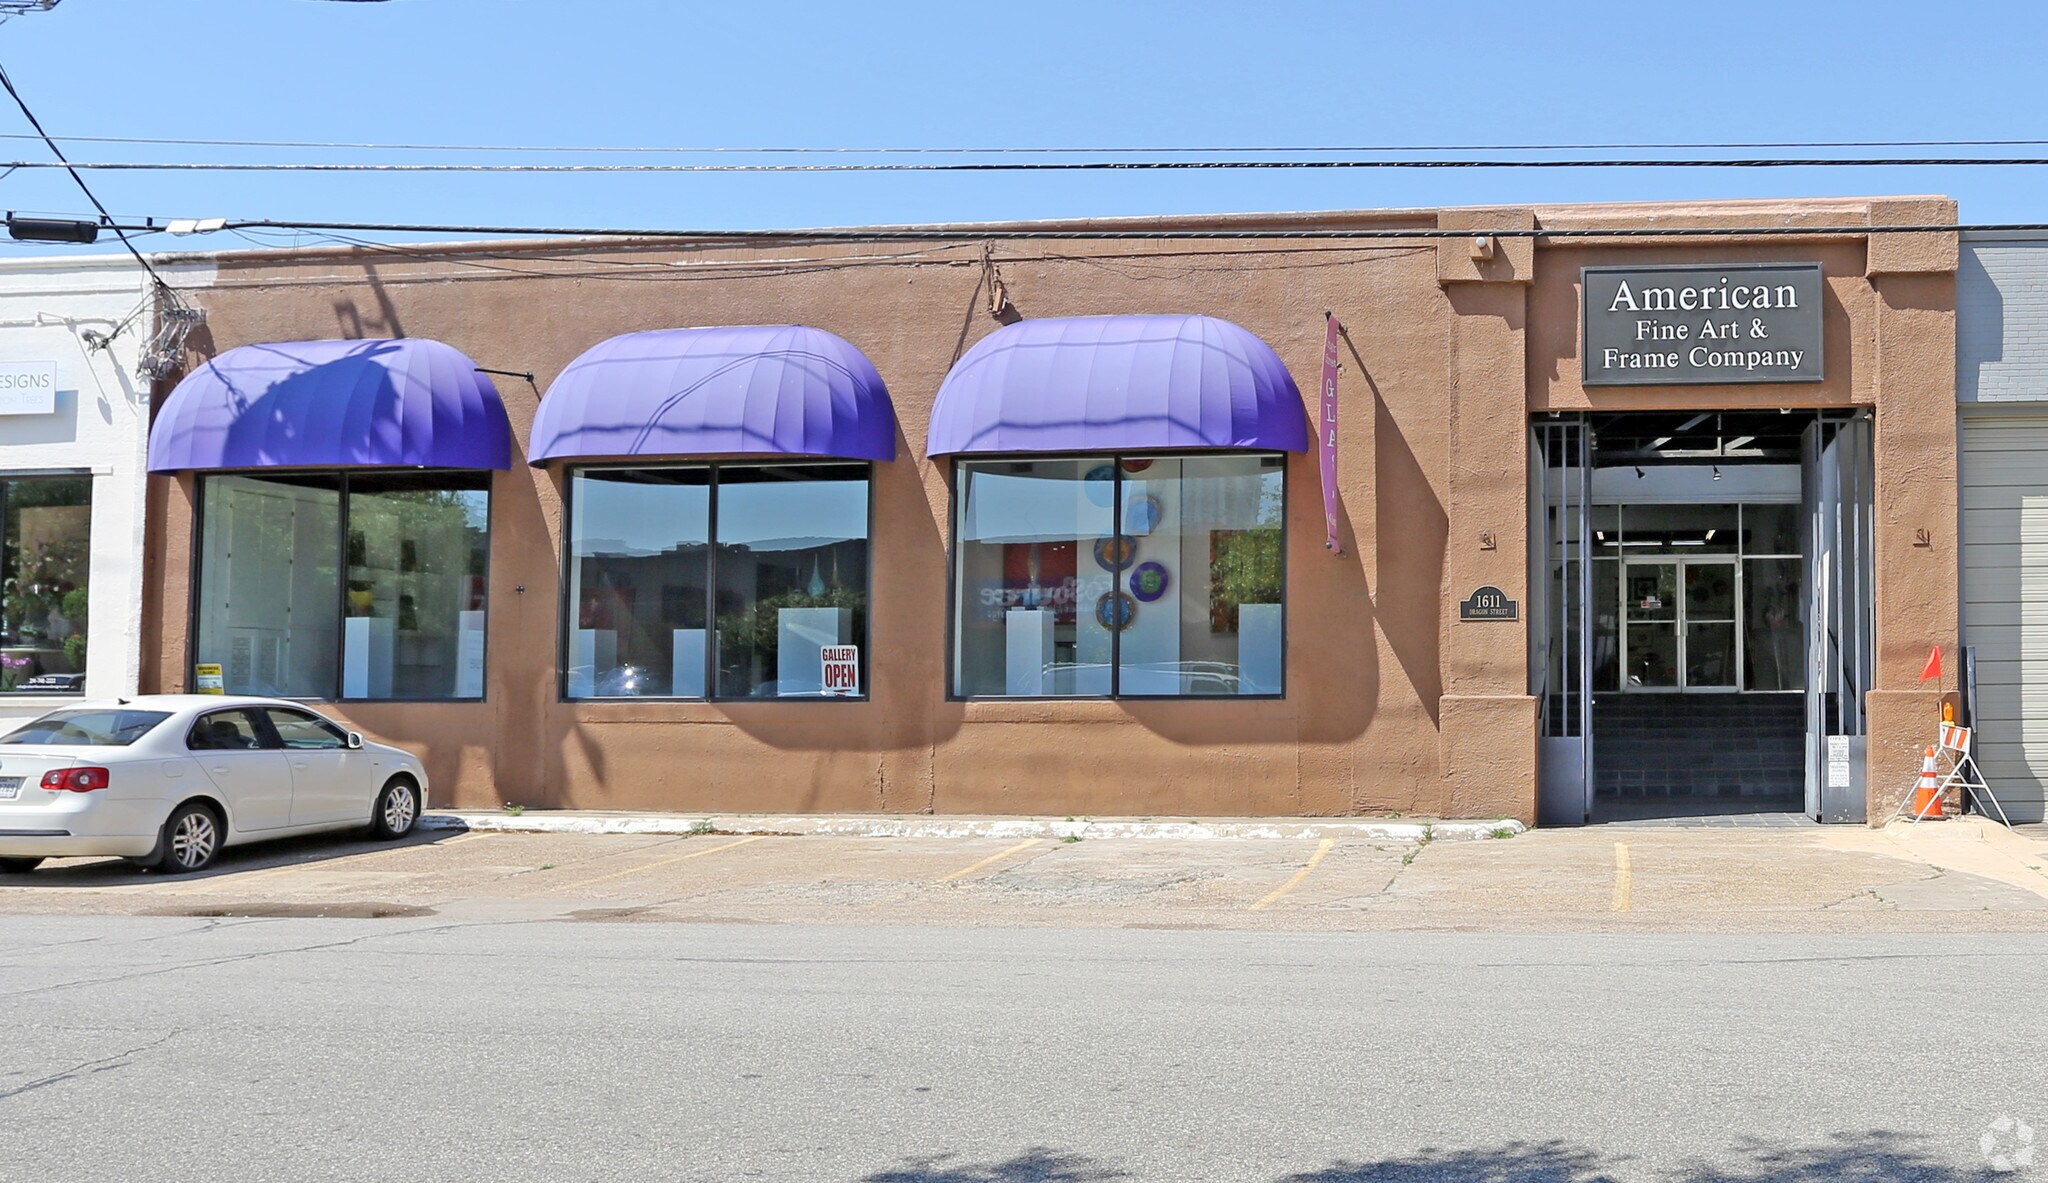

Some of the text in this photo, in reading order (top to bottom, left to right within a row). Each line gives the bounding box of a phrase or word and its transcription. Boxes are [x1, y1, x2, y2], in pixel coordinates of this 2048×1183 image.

[1608, 277, 1798, 312] American
[1635, 318, 1769, 341] Fine Art &
[1603, 346, 1804, 371] Frame Company
[1469, 608, 1508, 616] DRAGON STREET
[1477, 595, 1501, 608] 1611
[822, 648, 856, 661] GALLERY
[825, 663, 855, 688] OPEN
